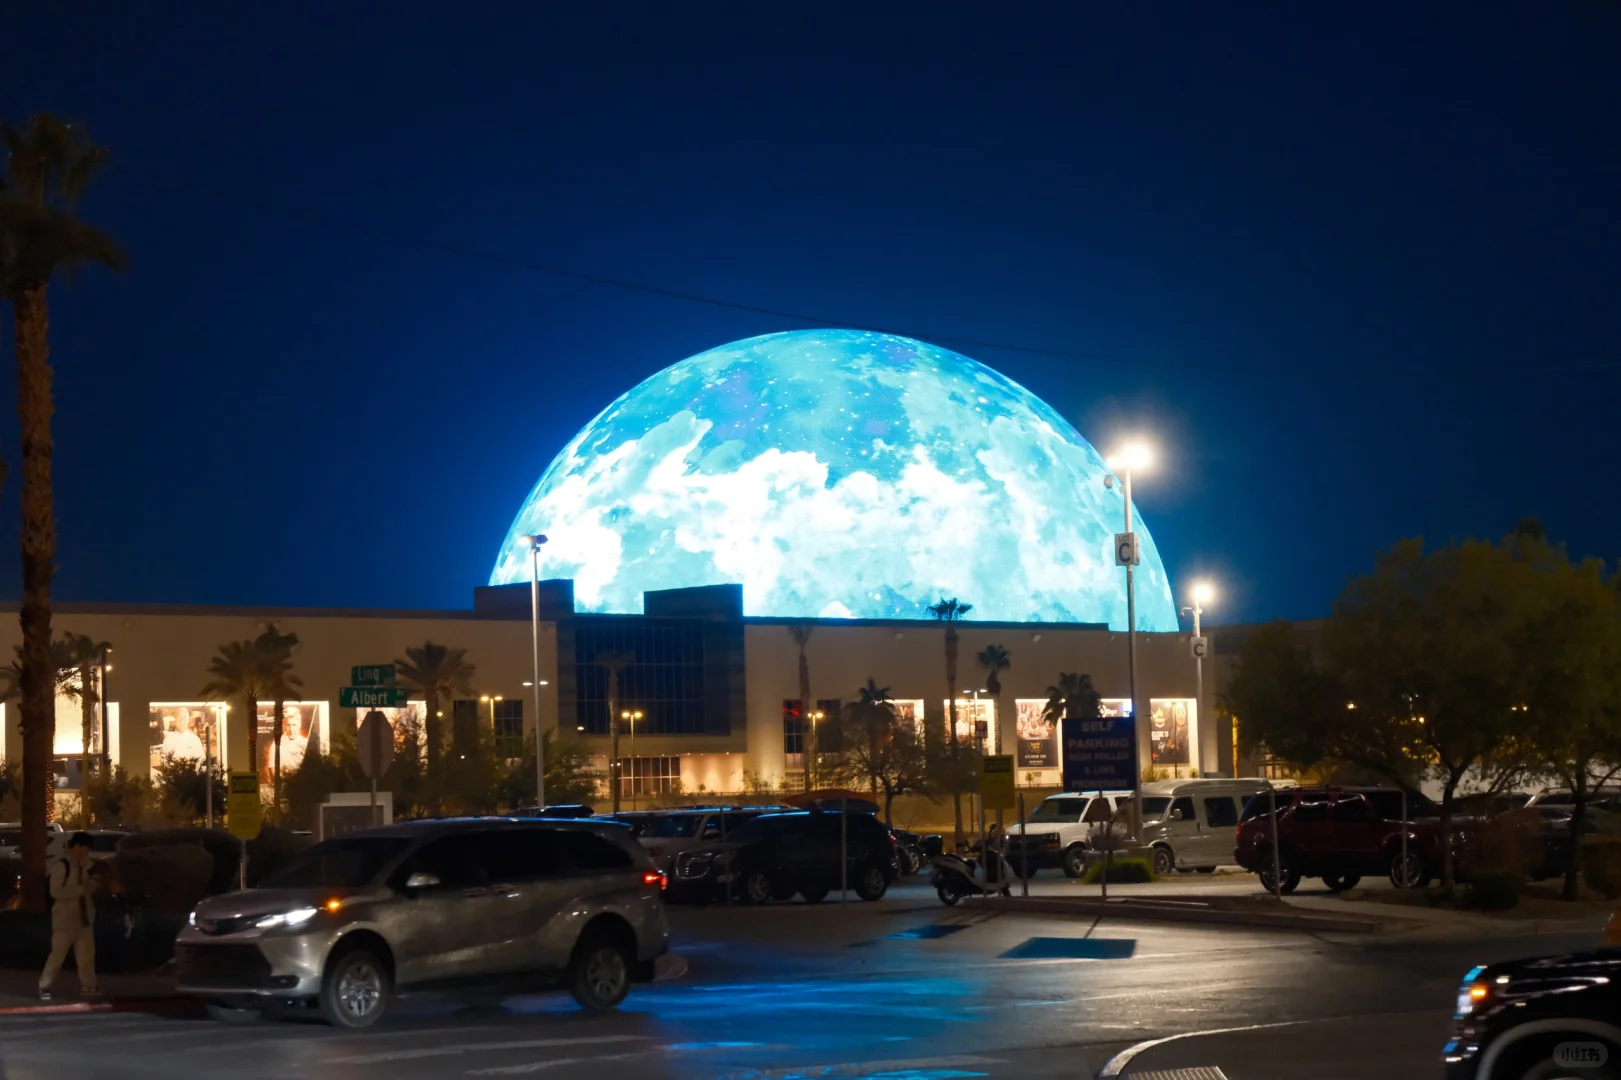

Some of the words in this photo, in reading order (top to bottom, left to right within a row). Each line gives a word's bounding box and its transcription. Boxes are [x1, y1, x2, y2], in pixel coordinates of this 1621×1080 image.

[1118, 534, 1130, 542] LOT
[1118, 542, 1131, 563] C
[1194, 643, 1204, 657] C
[358, 667, 380, 685] Linq
[351, 690, 388, 705] Albert
[1081, 720, 1115, 732] SELF
[1068, 737, 1129, 749] PARKING
